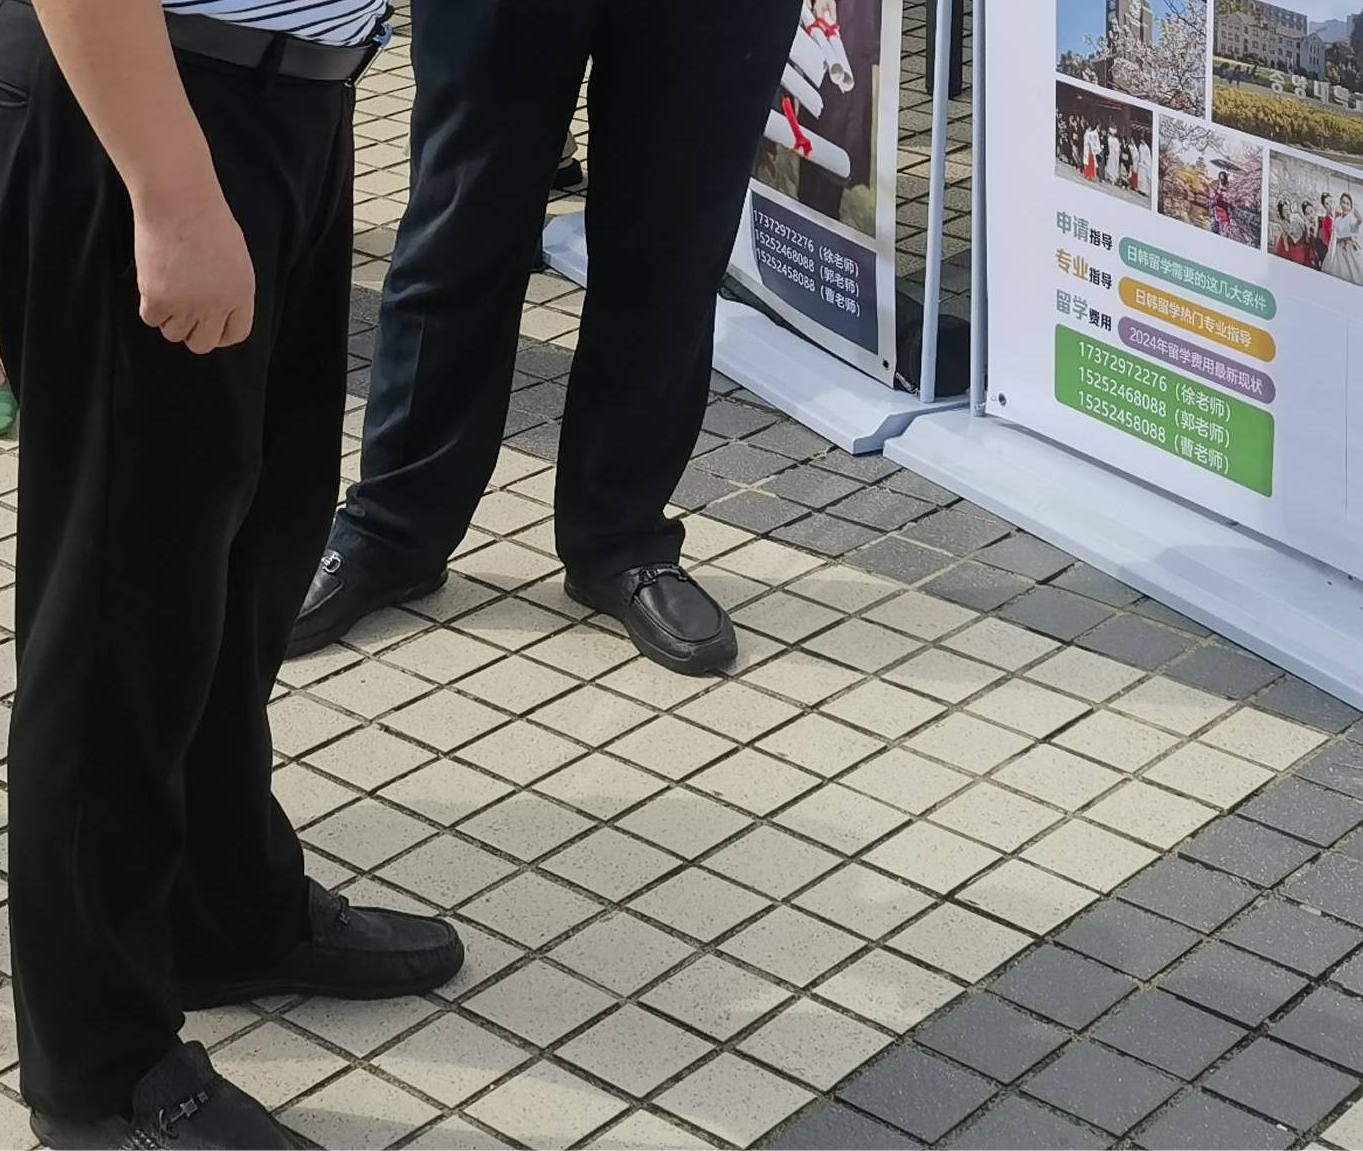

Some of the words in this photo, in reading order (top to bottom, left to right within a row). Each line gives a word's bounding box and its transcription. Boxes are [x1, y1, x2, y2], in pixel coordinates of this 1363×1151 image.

[1055, 248, 1113, 290] 专业指导
[1135, 288, 1253, 349] 日韩留学热门专业指导
[1056, 210, 1113, 251] 申请指导
[1127, 245, 1267, 314] 日韩留学需要的这几大条件
[1056, 289, 1112, 332] 留学费用
[1129, 327, 1263, 396] 2024年留学费用最新现状
[1078, 341, 1231, 421] 17372972276（徐老师）
[1077, 391, 1230, 475] 15252458088（曹老师）
[1078, 366, 1231, 448] 15252468088（郭老师）
